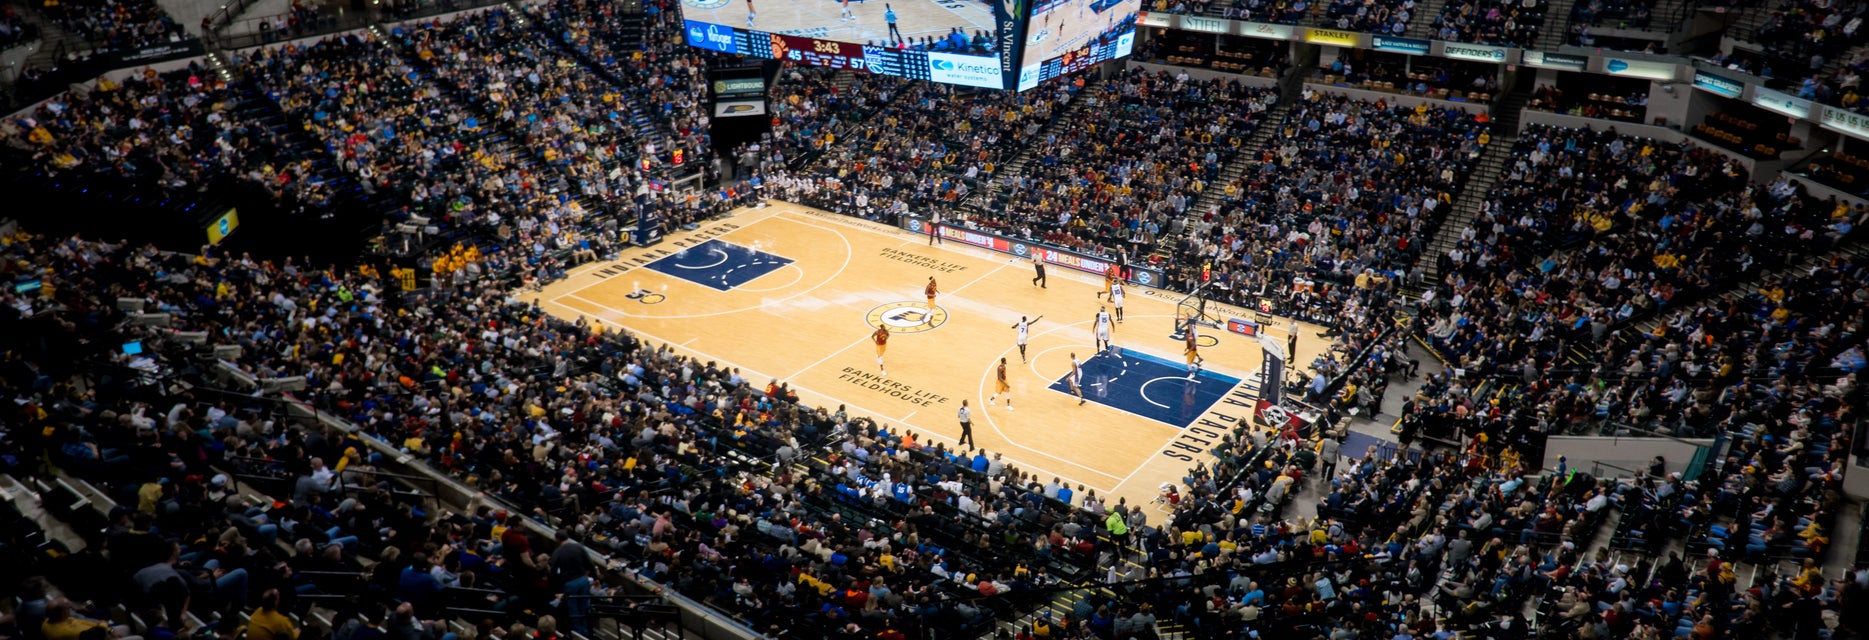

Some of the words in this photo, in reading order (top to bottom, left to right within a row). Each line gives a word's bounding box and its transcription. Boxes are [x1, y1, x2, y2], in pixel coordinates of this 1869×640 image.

[707, 24, 733, 52] Kroger
[1003, 21, 1014, 34] St.
[1314, 29, 1351, 40] STANLEY
[787, 49, 803, 61] 45
[813, 40, 840, 54] 3:43
[1003, 34, 1014, 72] Vincent
[1445, 46, 1493, 58] DEFENDERS
[850, 57, 865, 69] 57
[957, 62, 1000, 76] Kinetico
[726, 81, 764, 90] LIGHTBOUND
[591, 248, 672, 279] INDIANA
[673, 223, 740, 248] PACERS
[882, 247, 937, 264] BANKERS
[940, 261, 968, 271] LIFE
[1046, 250, 1058, 262] 24
[1058, 253, 1080, 267] MEALS
[1081, 258, 1104, 272] UNDER
[879, 252, 956, 274] FIELDHOUSE
[838, 374, 933, 408] FIELDHOUSE
[842, 366, 912, 392] BANKERS
[915, 389, 949, 404] LIFE
[1163, 411, 1238, 462] PACERS
